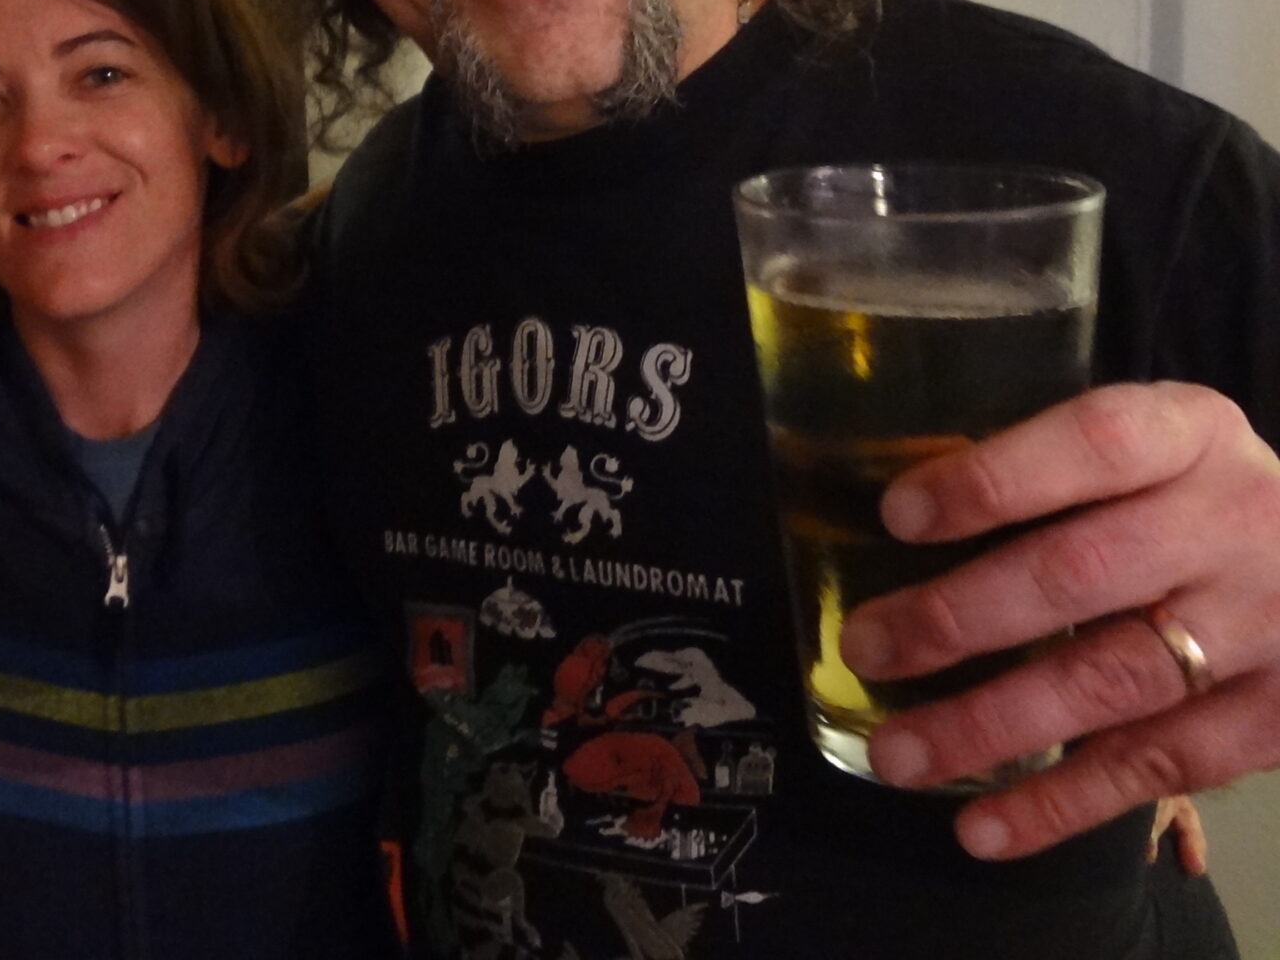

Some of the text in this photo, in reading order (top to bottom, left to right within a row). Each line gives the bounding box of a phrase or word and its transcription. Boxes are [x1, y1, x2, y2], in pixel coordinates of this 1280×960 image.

[427, 317, 693, 441] IGORS
[384, 530, 744, 607] BAR GAME ROOM & LAUNDROMAT
